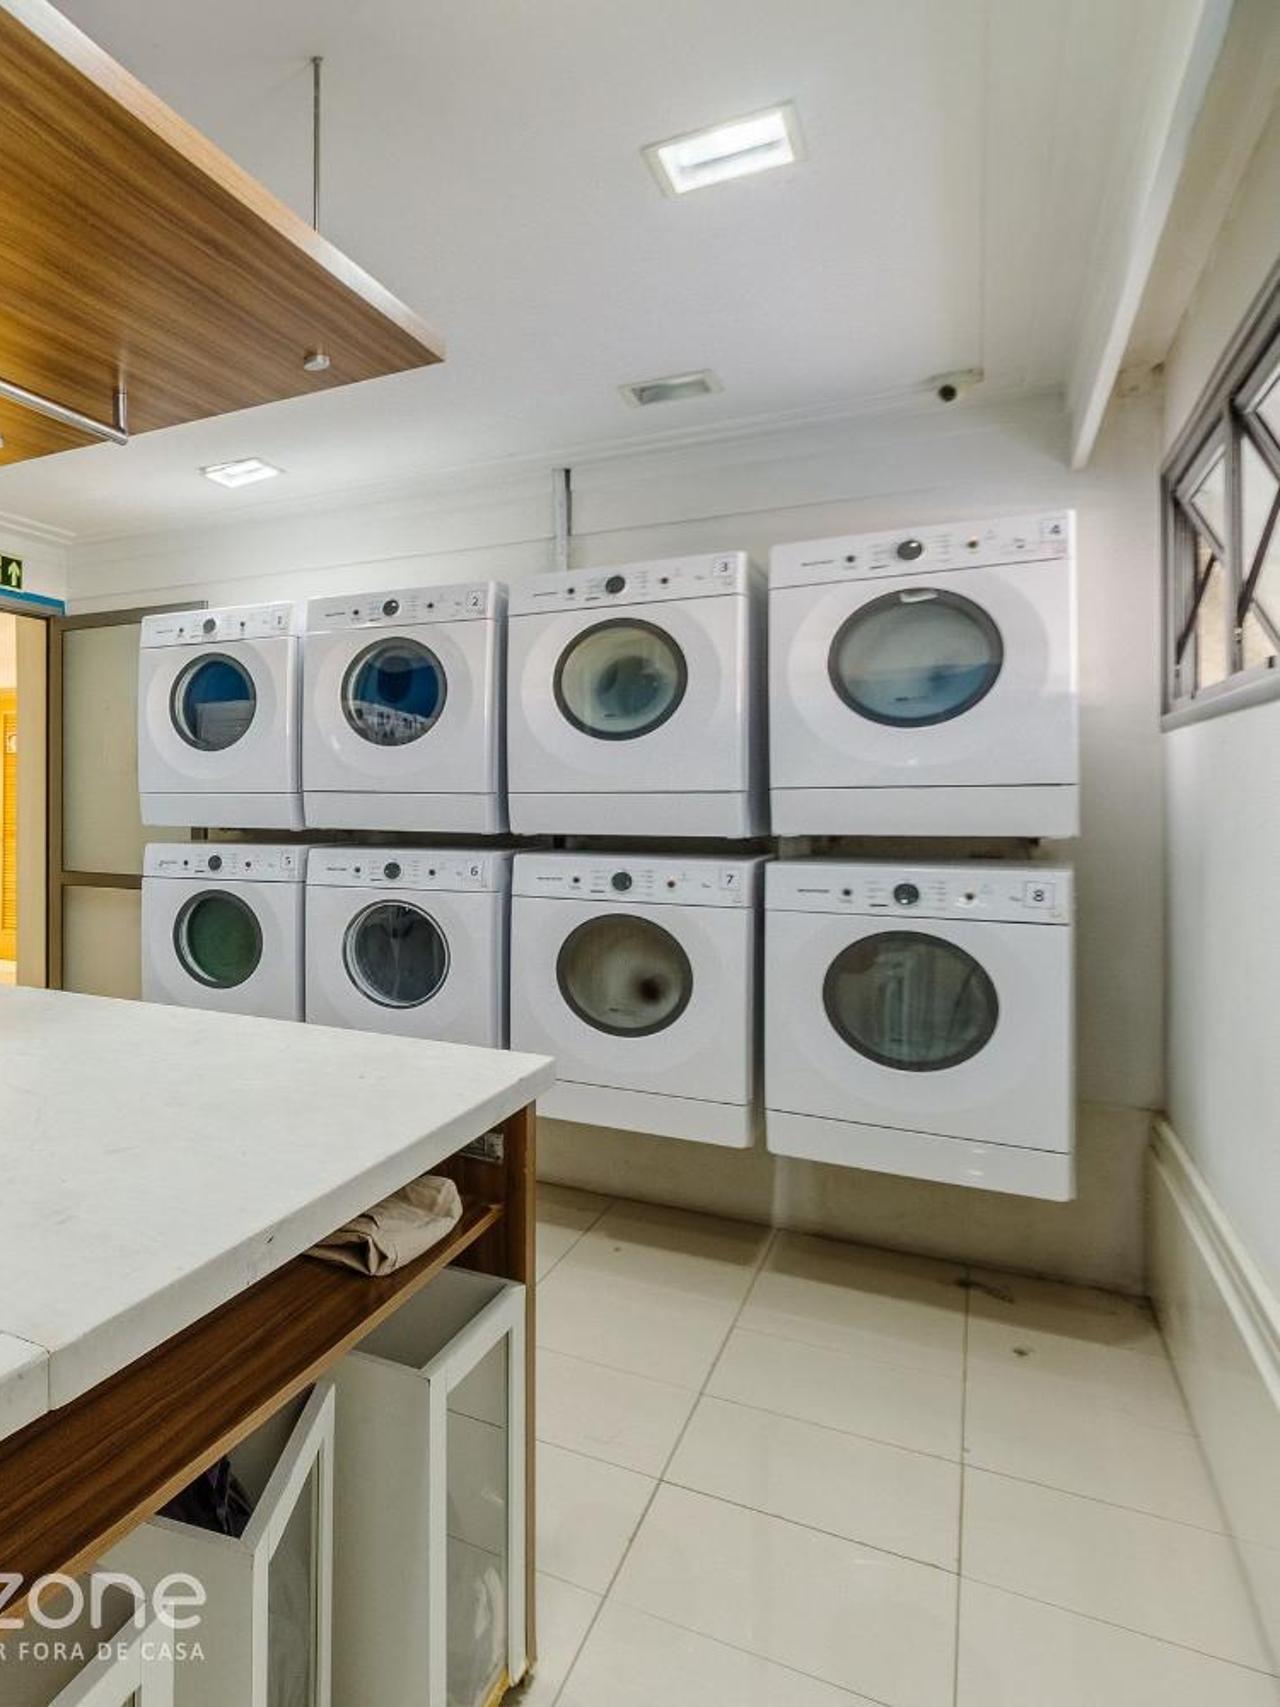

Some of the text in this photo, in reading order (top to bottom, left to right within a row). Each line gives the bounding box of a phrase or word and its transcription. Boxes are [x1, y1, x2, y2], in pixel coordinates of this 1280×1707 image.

[472, 595, 479, 607] 2
[470, 865, 479, 877] 6
[726, 873, 734, 886] 7
[1033, 889, 1045, 903] 8
